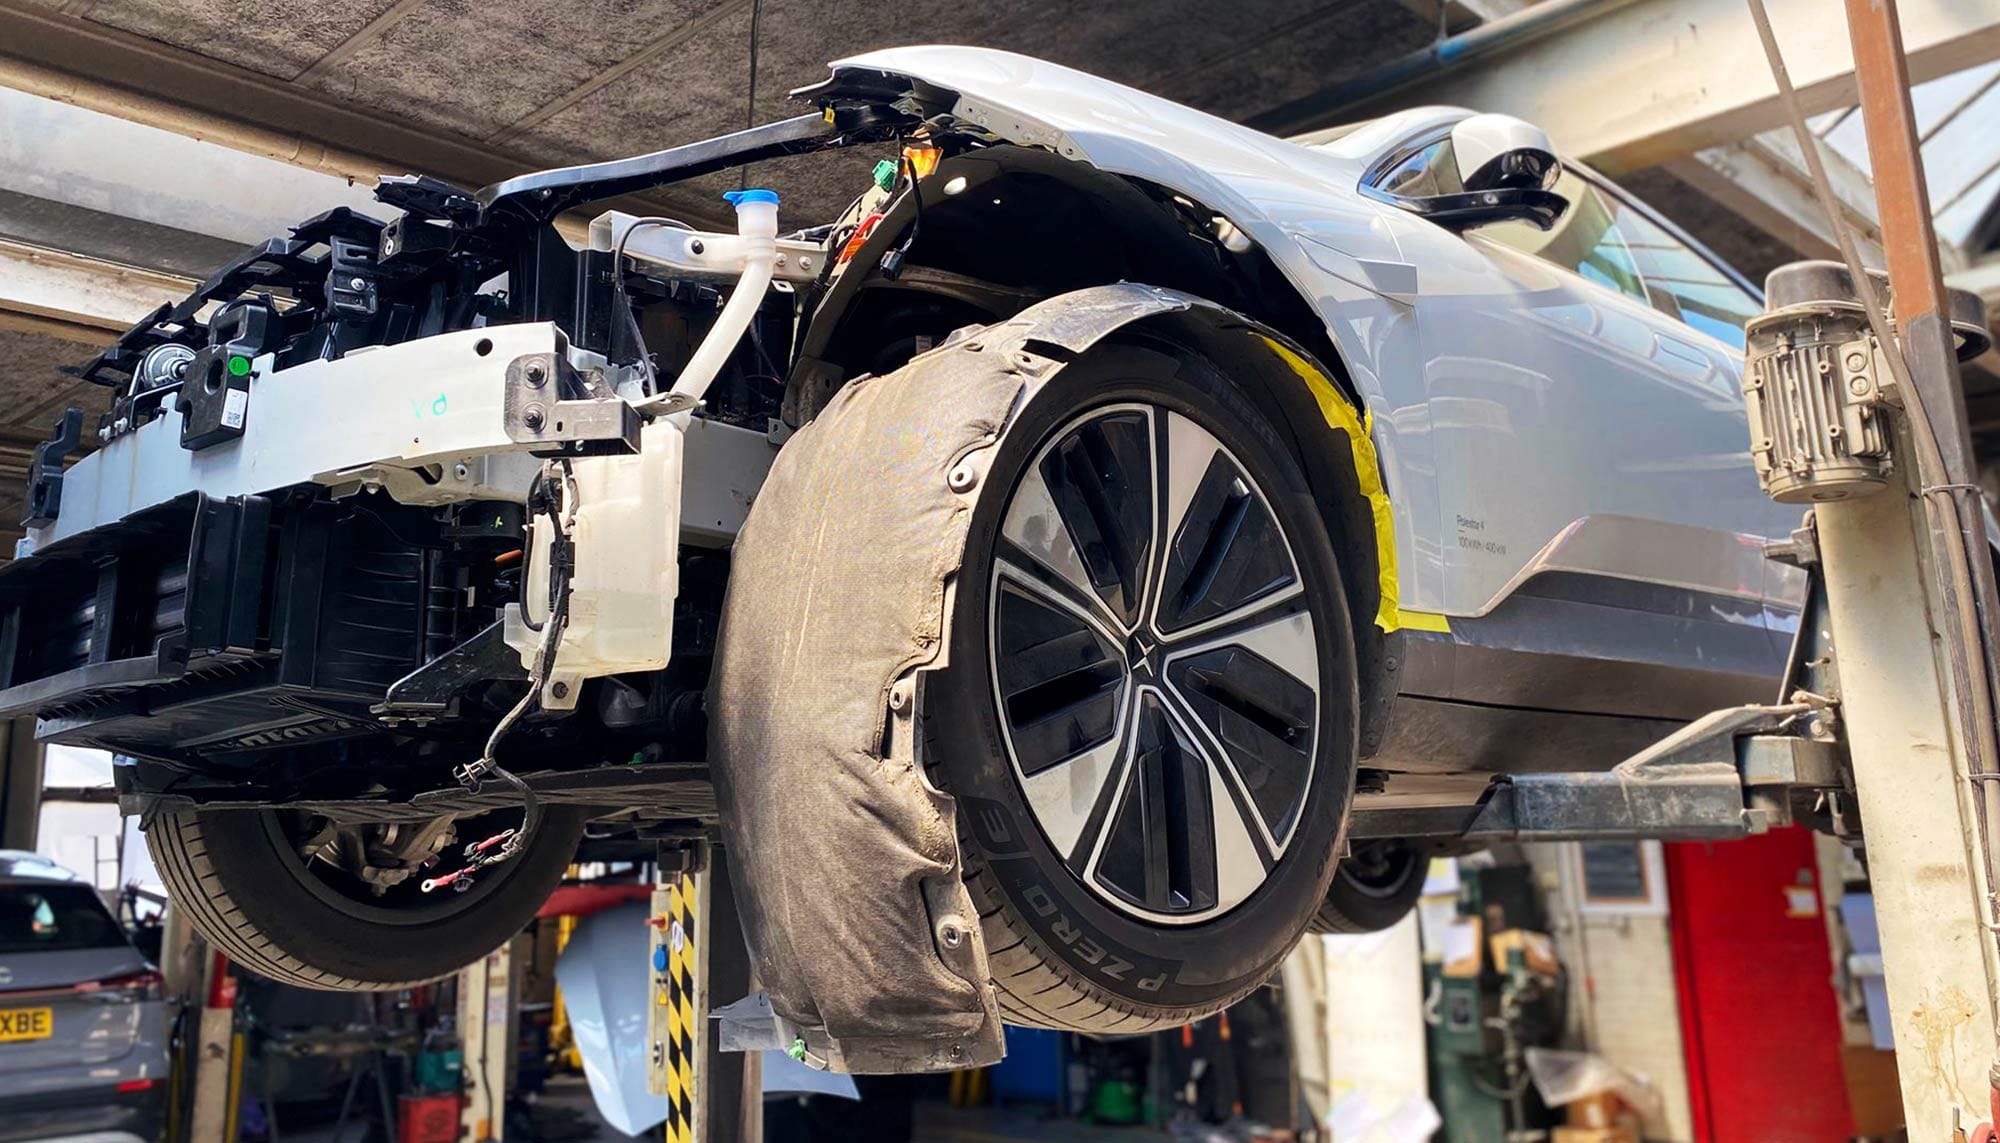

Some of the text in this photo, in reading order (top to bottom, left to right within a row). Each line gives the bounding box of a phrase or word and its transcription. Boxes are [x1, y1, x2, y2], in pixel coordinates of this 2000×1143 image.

[1457, 514, 1480, 530] Polestar
[1022, 884, 1168, 993] P ZERO
[0, 1011, 46, 1035] XBE
